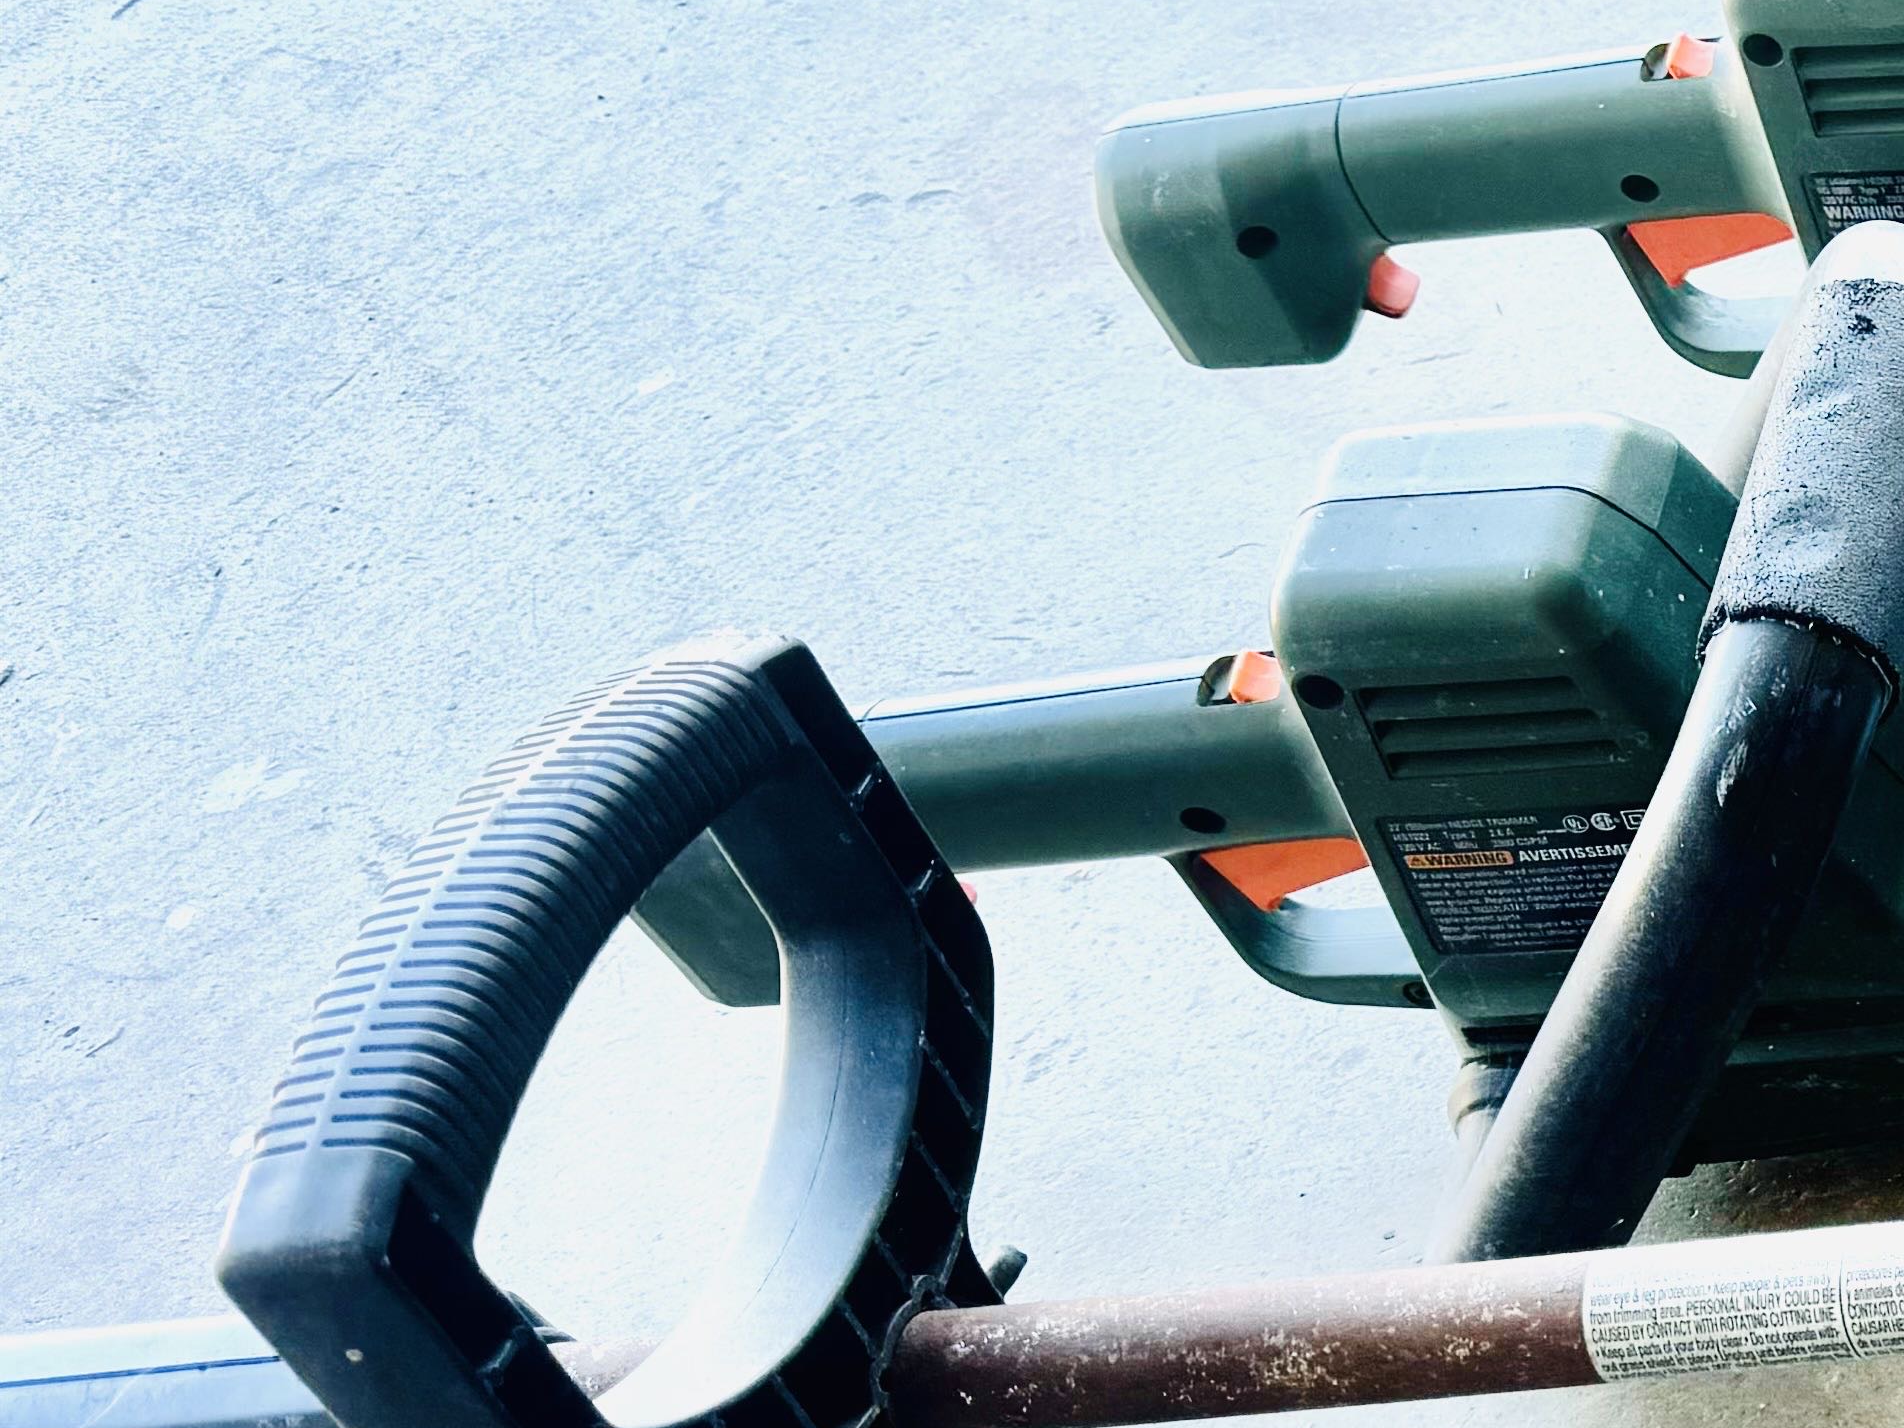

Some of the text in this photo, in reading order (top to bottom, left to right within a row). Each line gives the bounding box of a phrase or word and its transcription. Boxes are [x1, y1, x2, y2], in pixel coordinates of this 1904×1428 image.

[1425, 852, 1508, 866] WARNING
[1519, 843, 1631, 863] AVERTISSEME
[1613, 1291, 1631, 1309] eye
[1713, 1280, 1738, 1295] Keep
[1739, 1278, 1771, 1294] people
[1782, 1274, 1805, 1291] pets
[1853, 1283, 1893, 1301] animales
[1589, 1287, 1837, 1326] from trimming PERSONAL INJURY COULD BE
[1847, 1299, 1899, 1320] CONTACTO
[1591, 1305, 1837, 1344] CAUSED BY CONTACT WITH ROTATING CUTTING LINE
[1851, 1318, 1892, 1337] CAUSAR
[1599, 1327, 1818, 1360] Keep all parts of your body Do not operate
[1619, 1359, 1647, 1374] grass
[1646, 1354, 1676, 1370] shield
[1773, 1344, 1808, 1357] before
[1807, 1342, 1851, 1354] cleaning
